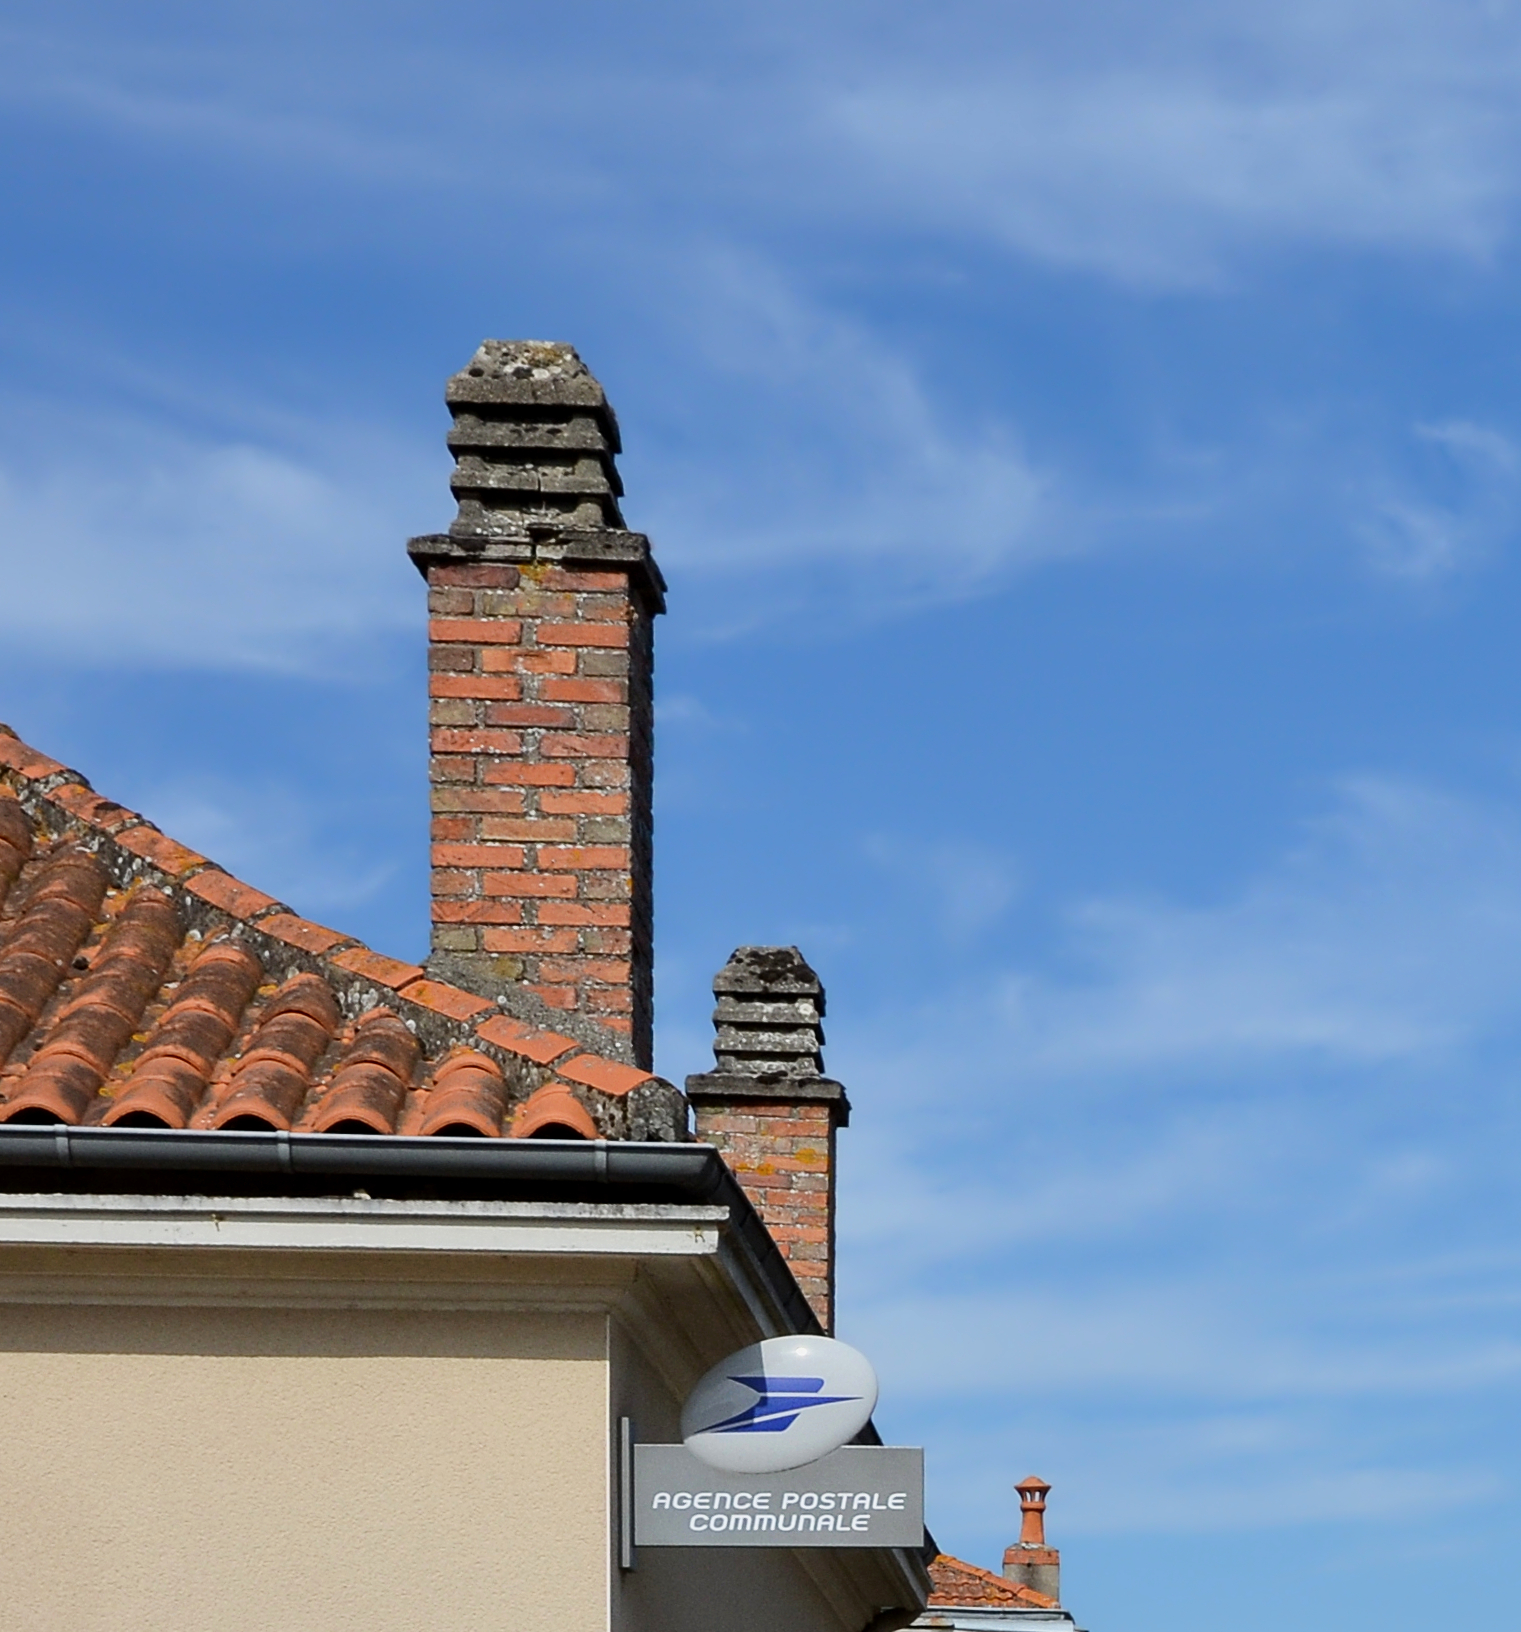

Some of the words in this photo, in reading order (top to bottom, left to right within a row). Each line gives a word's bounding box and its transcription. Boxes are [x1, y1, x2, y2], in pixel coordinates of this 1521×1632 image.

[652, 1492, 772, 1510] AGENCE
[781, 1492, 907, 1511] POSTALE
[689, 1514, 871, 1532] COMMUNALE
